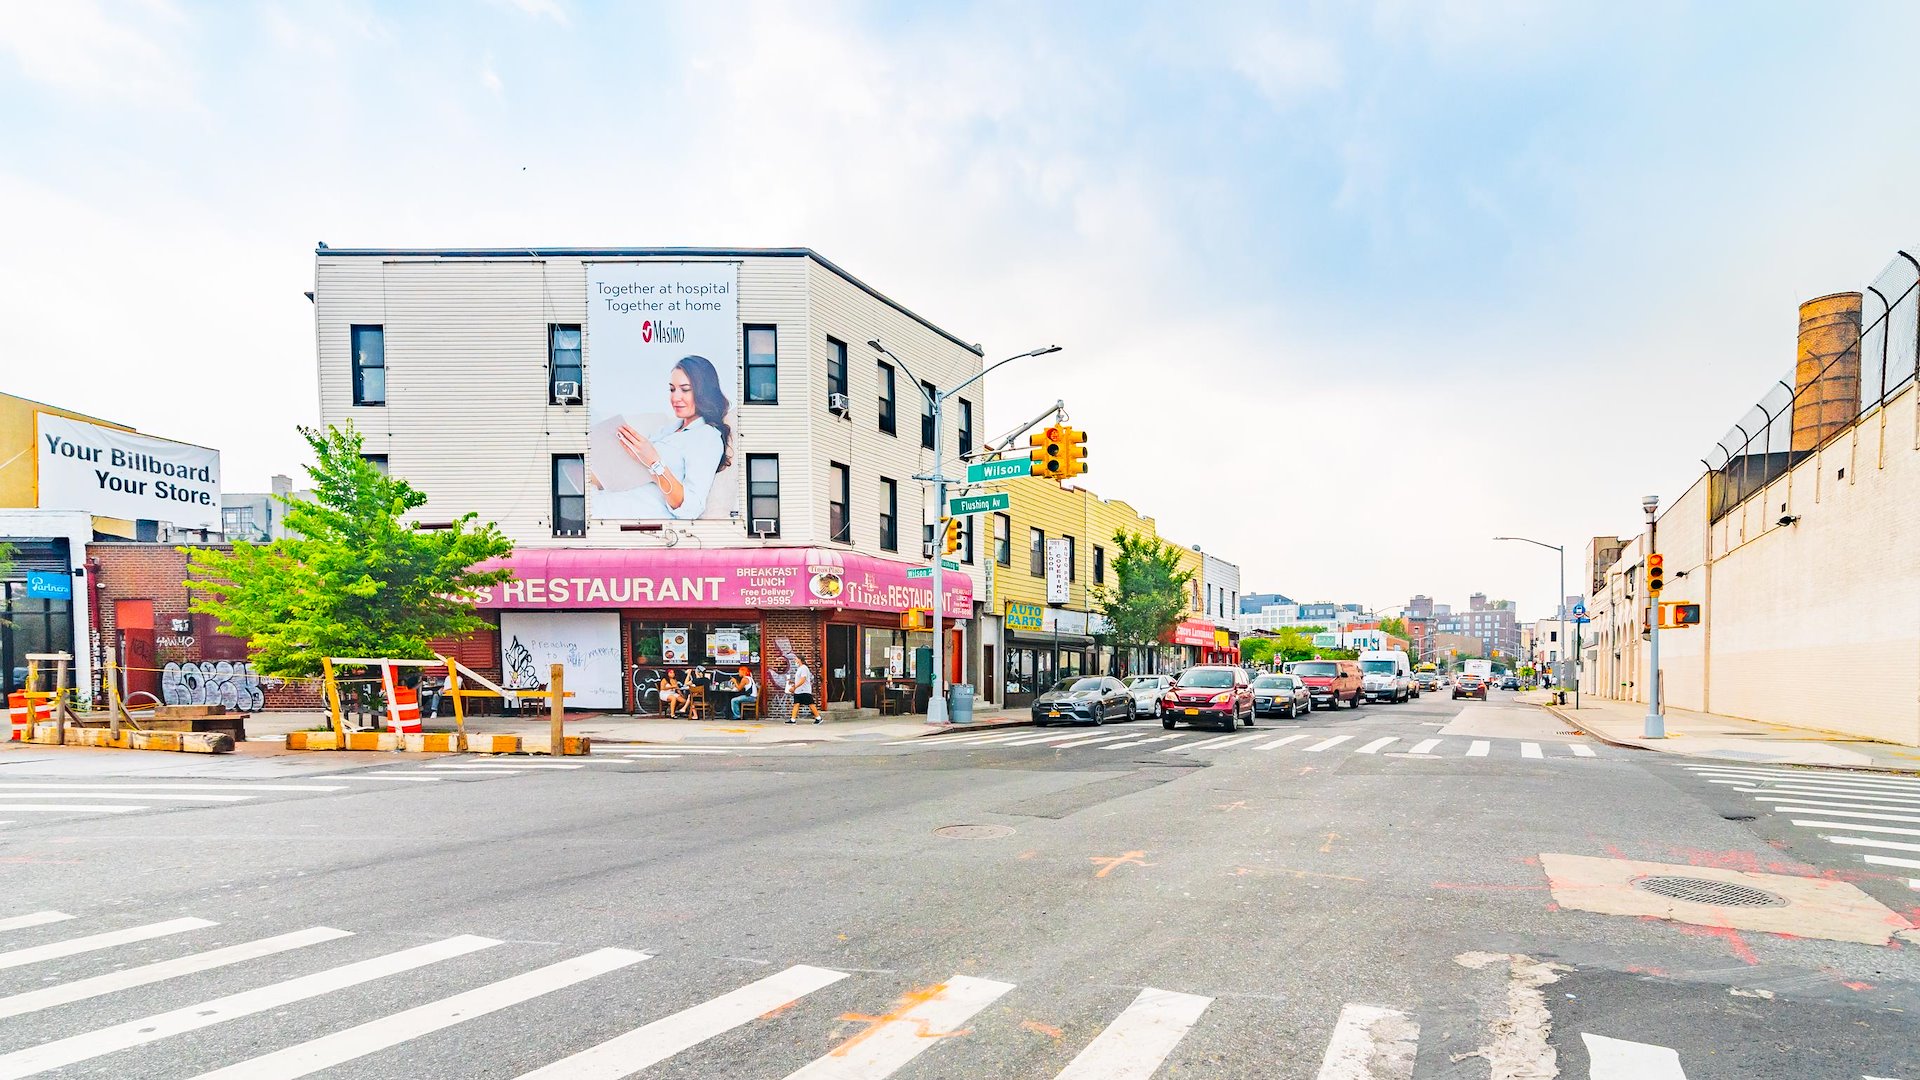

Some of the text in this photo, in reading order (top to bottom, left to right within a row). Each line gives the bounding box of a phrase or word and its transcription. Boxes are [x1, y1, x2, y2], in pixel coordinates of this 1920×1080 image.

[596, 281, 729, 297] Together at hospital
[605, 298, 721, 314] Together at home
[45, 433, 216, 484] Your Billboard.
[983, 463, 1021, 478] Wilson
[95, 469, 216, 507] Your Store.
[961, 498, 1001, 511] Flushing Av
[736, 567, 799, 577] BREAKFAST
[907, 569, 927, 578] Wilson
[503, 576, 726, 603] RESTAURANT
[750, 577, 786, 587] LUNCH
[740, 588, 795, 597] Free Delivery
[846, 581, 952, 613] Tina's RESTAURNT
[744, 597, 791, 606] 821-9595
[1010, 602, 1042, 617] AUTO
[1007, 614, 1043, 627] PARTS
